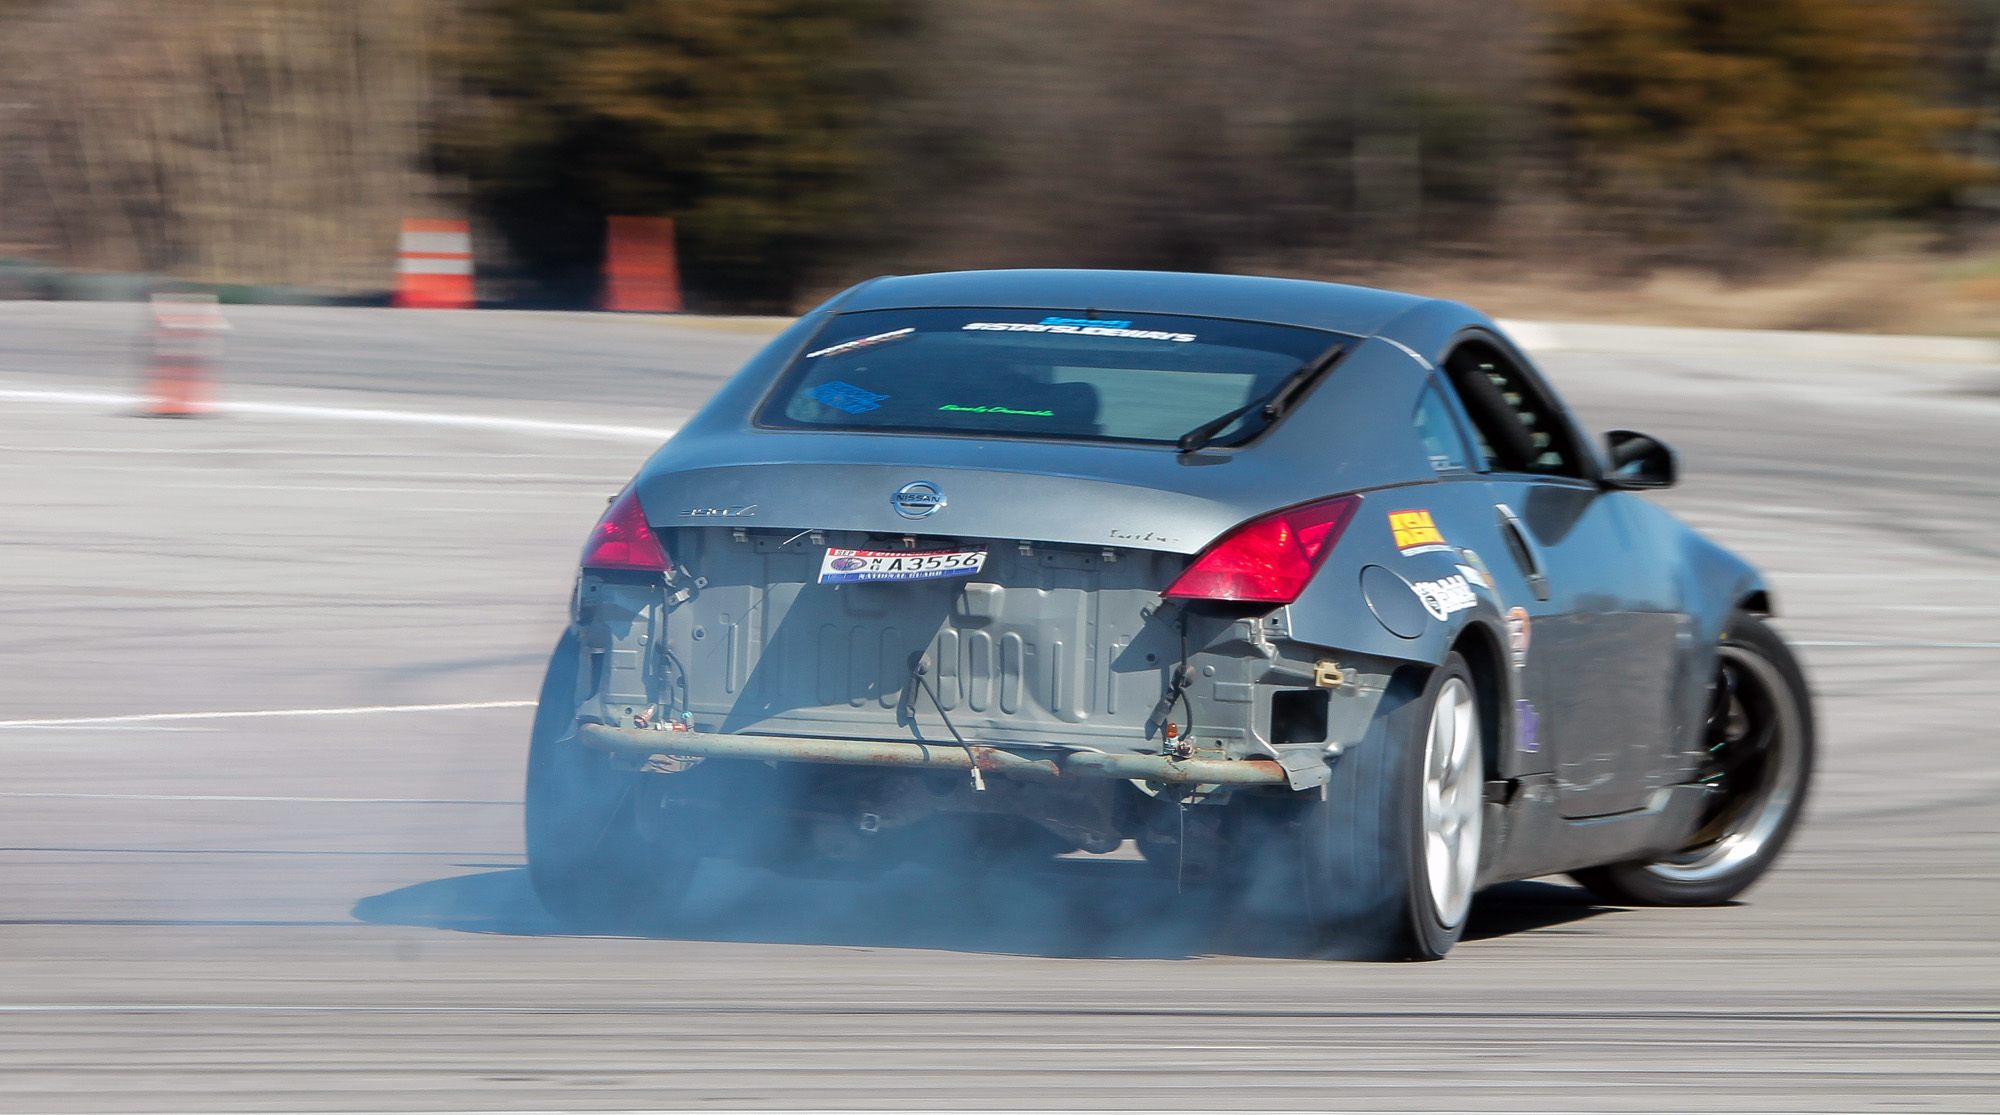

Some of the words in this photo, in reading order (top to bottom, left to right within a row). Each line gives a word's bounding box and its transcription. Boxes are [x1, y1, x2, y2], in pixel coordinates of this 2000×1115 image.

[896, 494, 941, 503] NISSAN
[679, 504, 758, 518] 350Z
[887, 553, 979, 572] A3556
